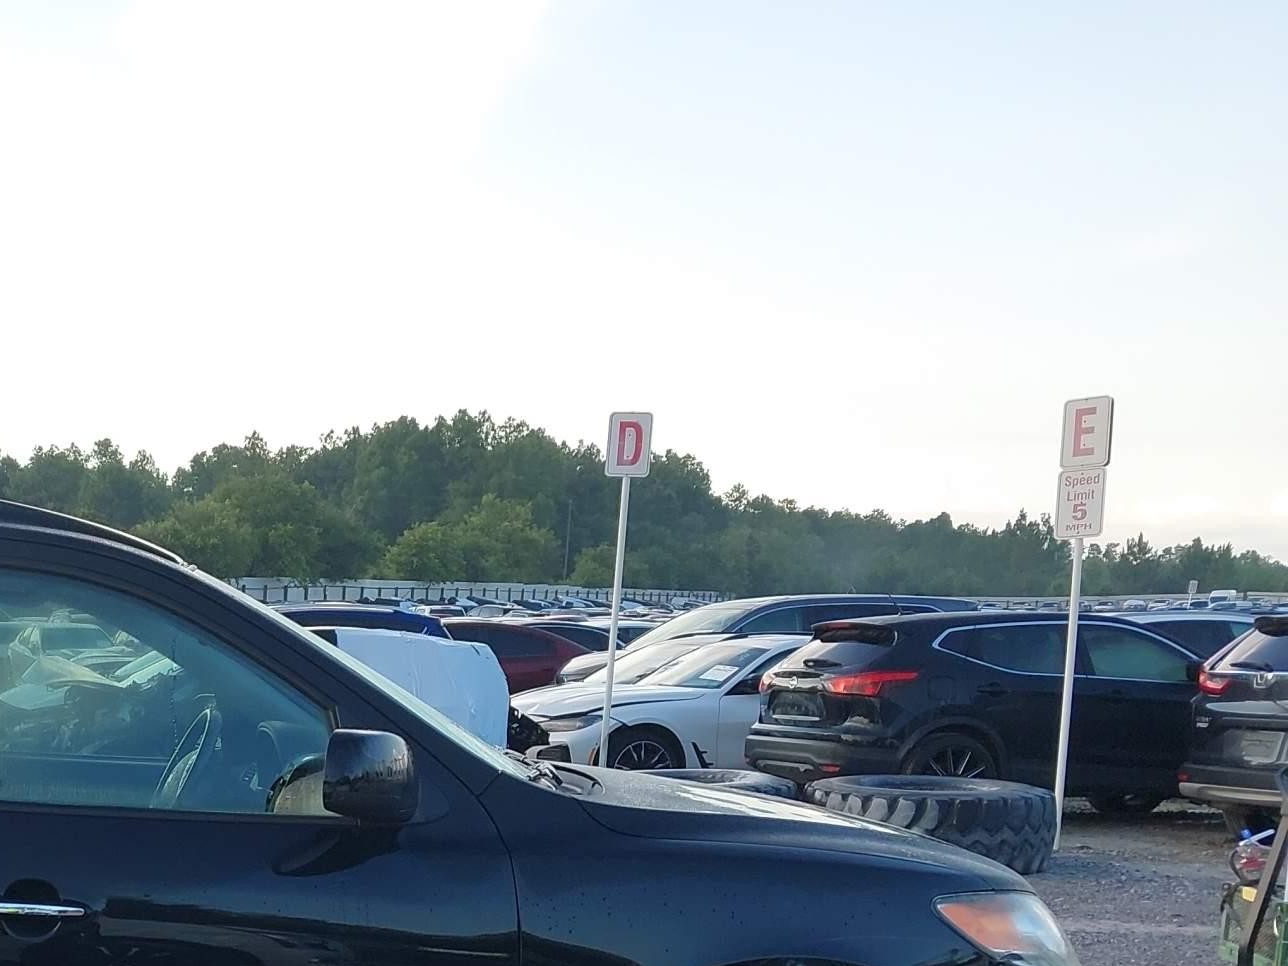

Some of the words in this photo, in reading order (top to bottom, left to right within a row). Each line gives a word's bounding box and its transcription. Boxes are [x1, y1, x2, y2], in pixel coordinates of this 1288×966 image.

[1072, 406, 1097, 458] E
[616, 421, 643, 467] D
[1064, 473, 1101, 489] Speed
[1067, 489, 1095, 502] Limit
[1072, 503, 1088, 521] 5
[1065, 523, 1093, 531] MPH
